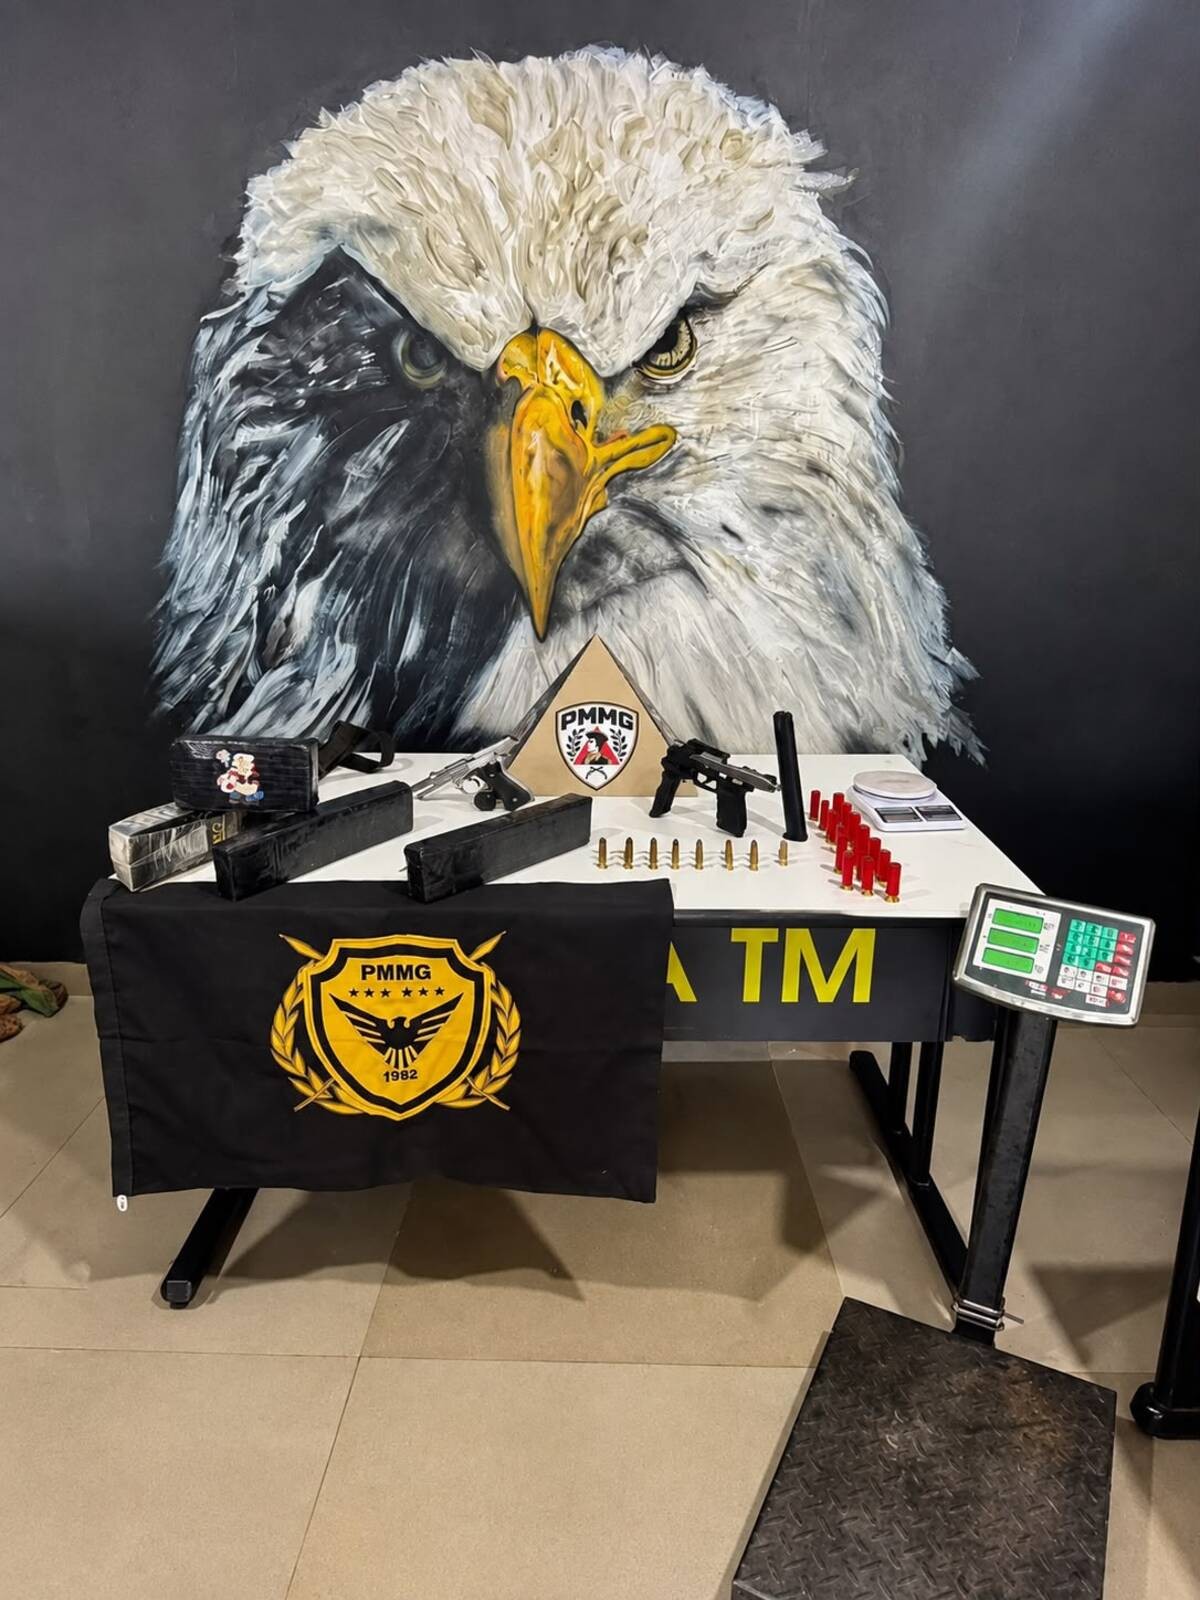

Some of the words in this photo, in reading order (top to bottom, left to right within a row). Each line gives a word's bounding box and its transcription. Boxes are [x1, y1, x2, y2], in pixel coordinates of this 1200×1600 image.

[561, 707, 634, 731] PMMG
[361, 964, 431, 980] PMMG
[730, 927, 877, 1003] TM
[384, 1069, 418, 1082] 1982
